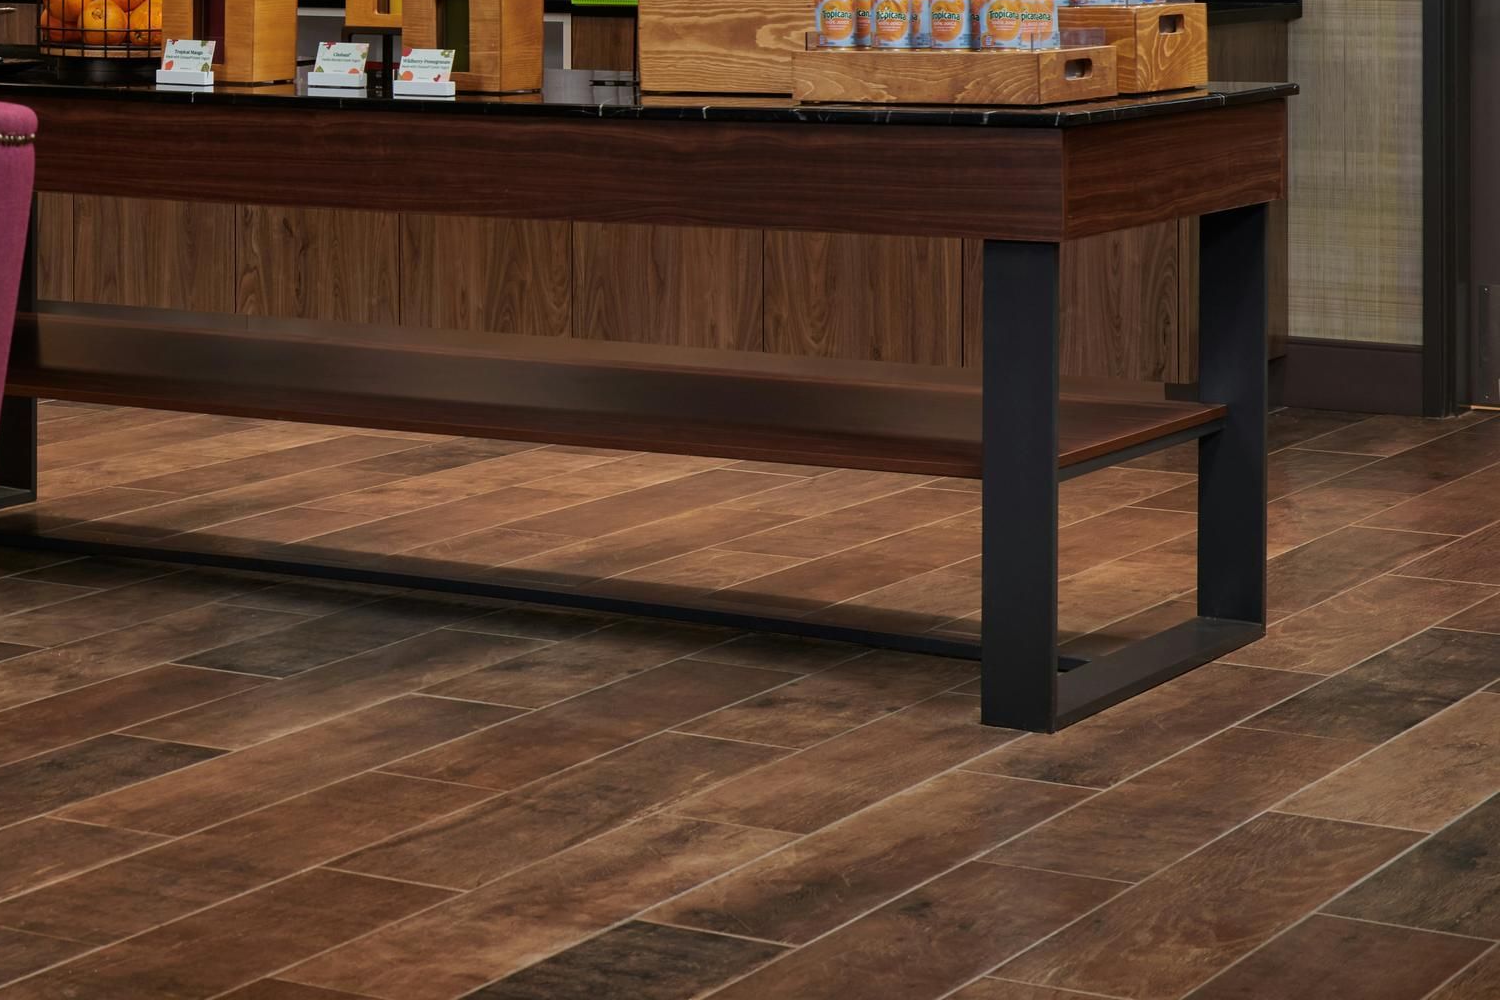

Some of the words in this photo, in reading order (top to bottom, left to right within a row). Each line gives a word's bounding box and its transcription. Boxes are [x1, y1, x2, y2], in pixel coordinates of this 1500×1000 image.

[821, 9, 852, 20] Tropicana
[876, 10, 906, 21] Tropicana
[988, 10, 1019, 20] Tropicana
